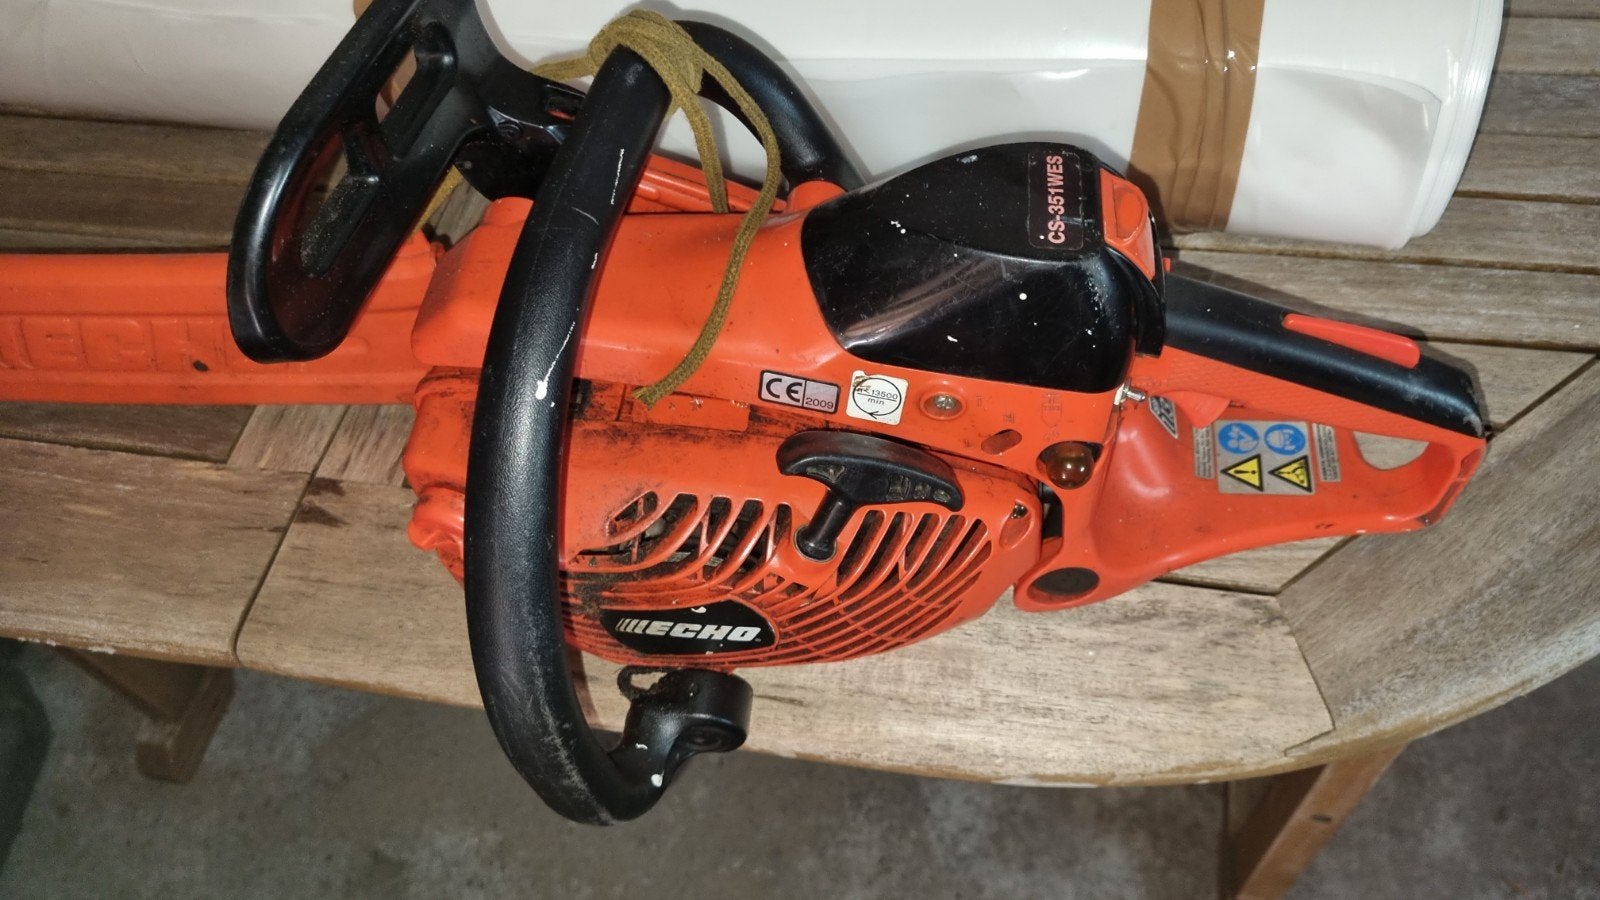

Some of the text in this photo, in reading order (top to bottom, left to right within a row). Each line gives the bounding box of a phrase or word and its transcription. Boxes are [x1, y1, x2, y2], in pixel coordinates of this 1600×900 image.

[1046, 155, 1066, 244] CS-351WES
[765, 377, 803, 403] CE
[805, 397, 834, 410] 2009
[867, 397, 885, 407] min
[644, 620, 762, 643] ECHO
